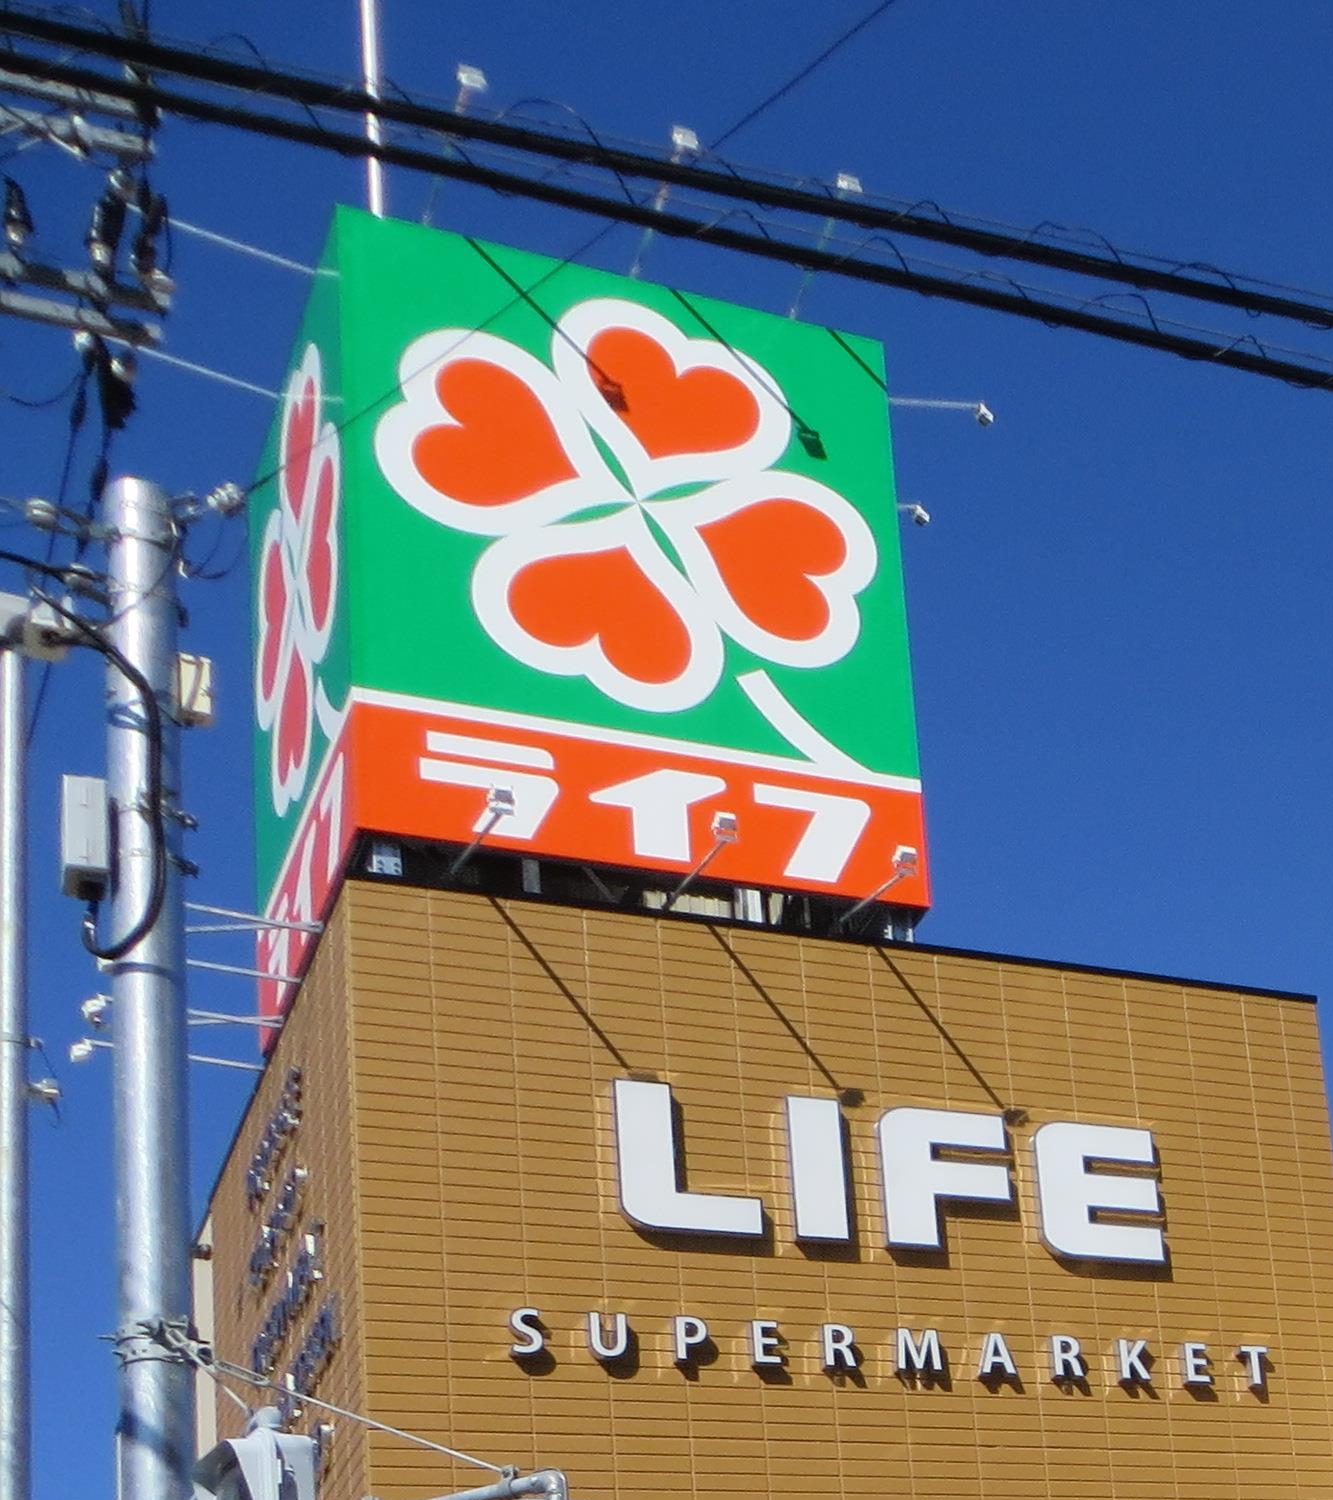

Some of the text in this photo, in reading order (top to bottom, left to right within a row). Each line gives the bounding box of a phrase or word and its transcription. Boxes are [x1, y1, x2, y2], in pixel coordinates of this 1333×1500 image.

[419, 730, 872, 882] ライフ
[613, 1078, 1165, 1264] LIFE
[509, 1308, 1270, 1388] SUPERMARKET
